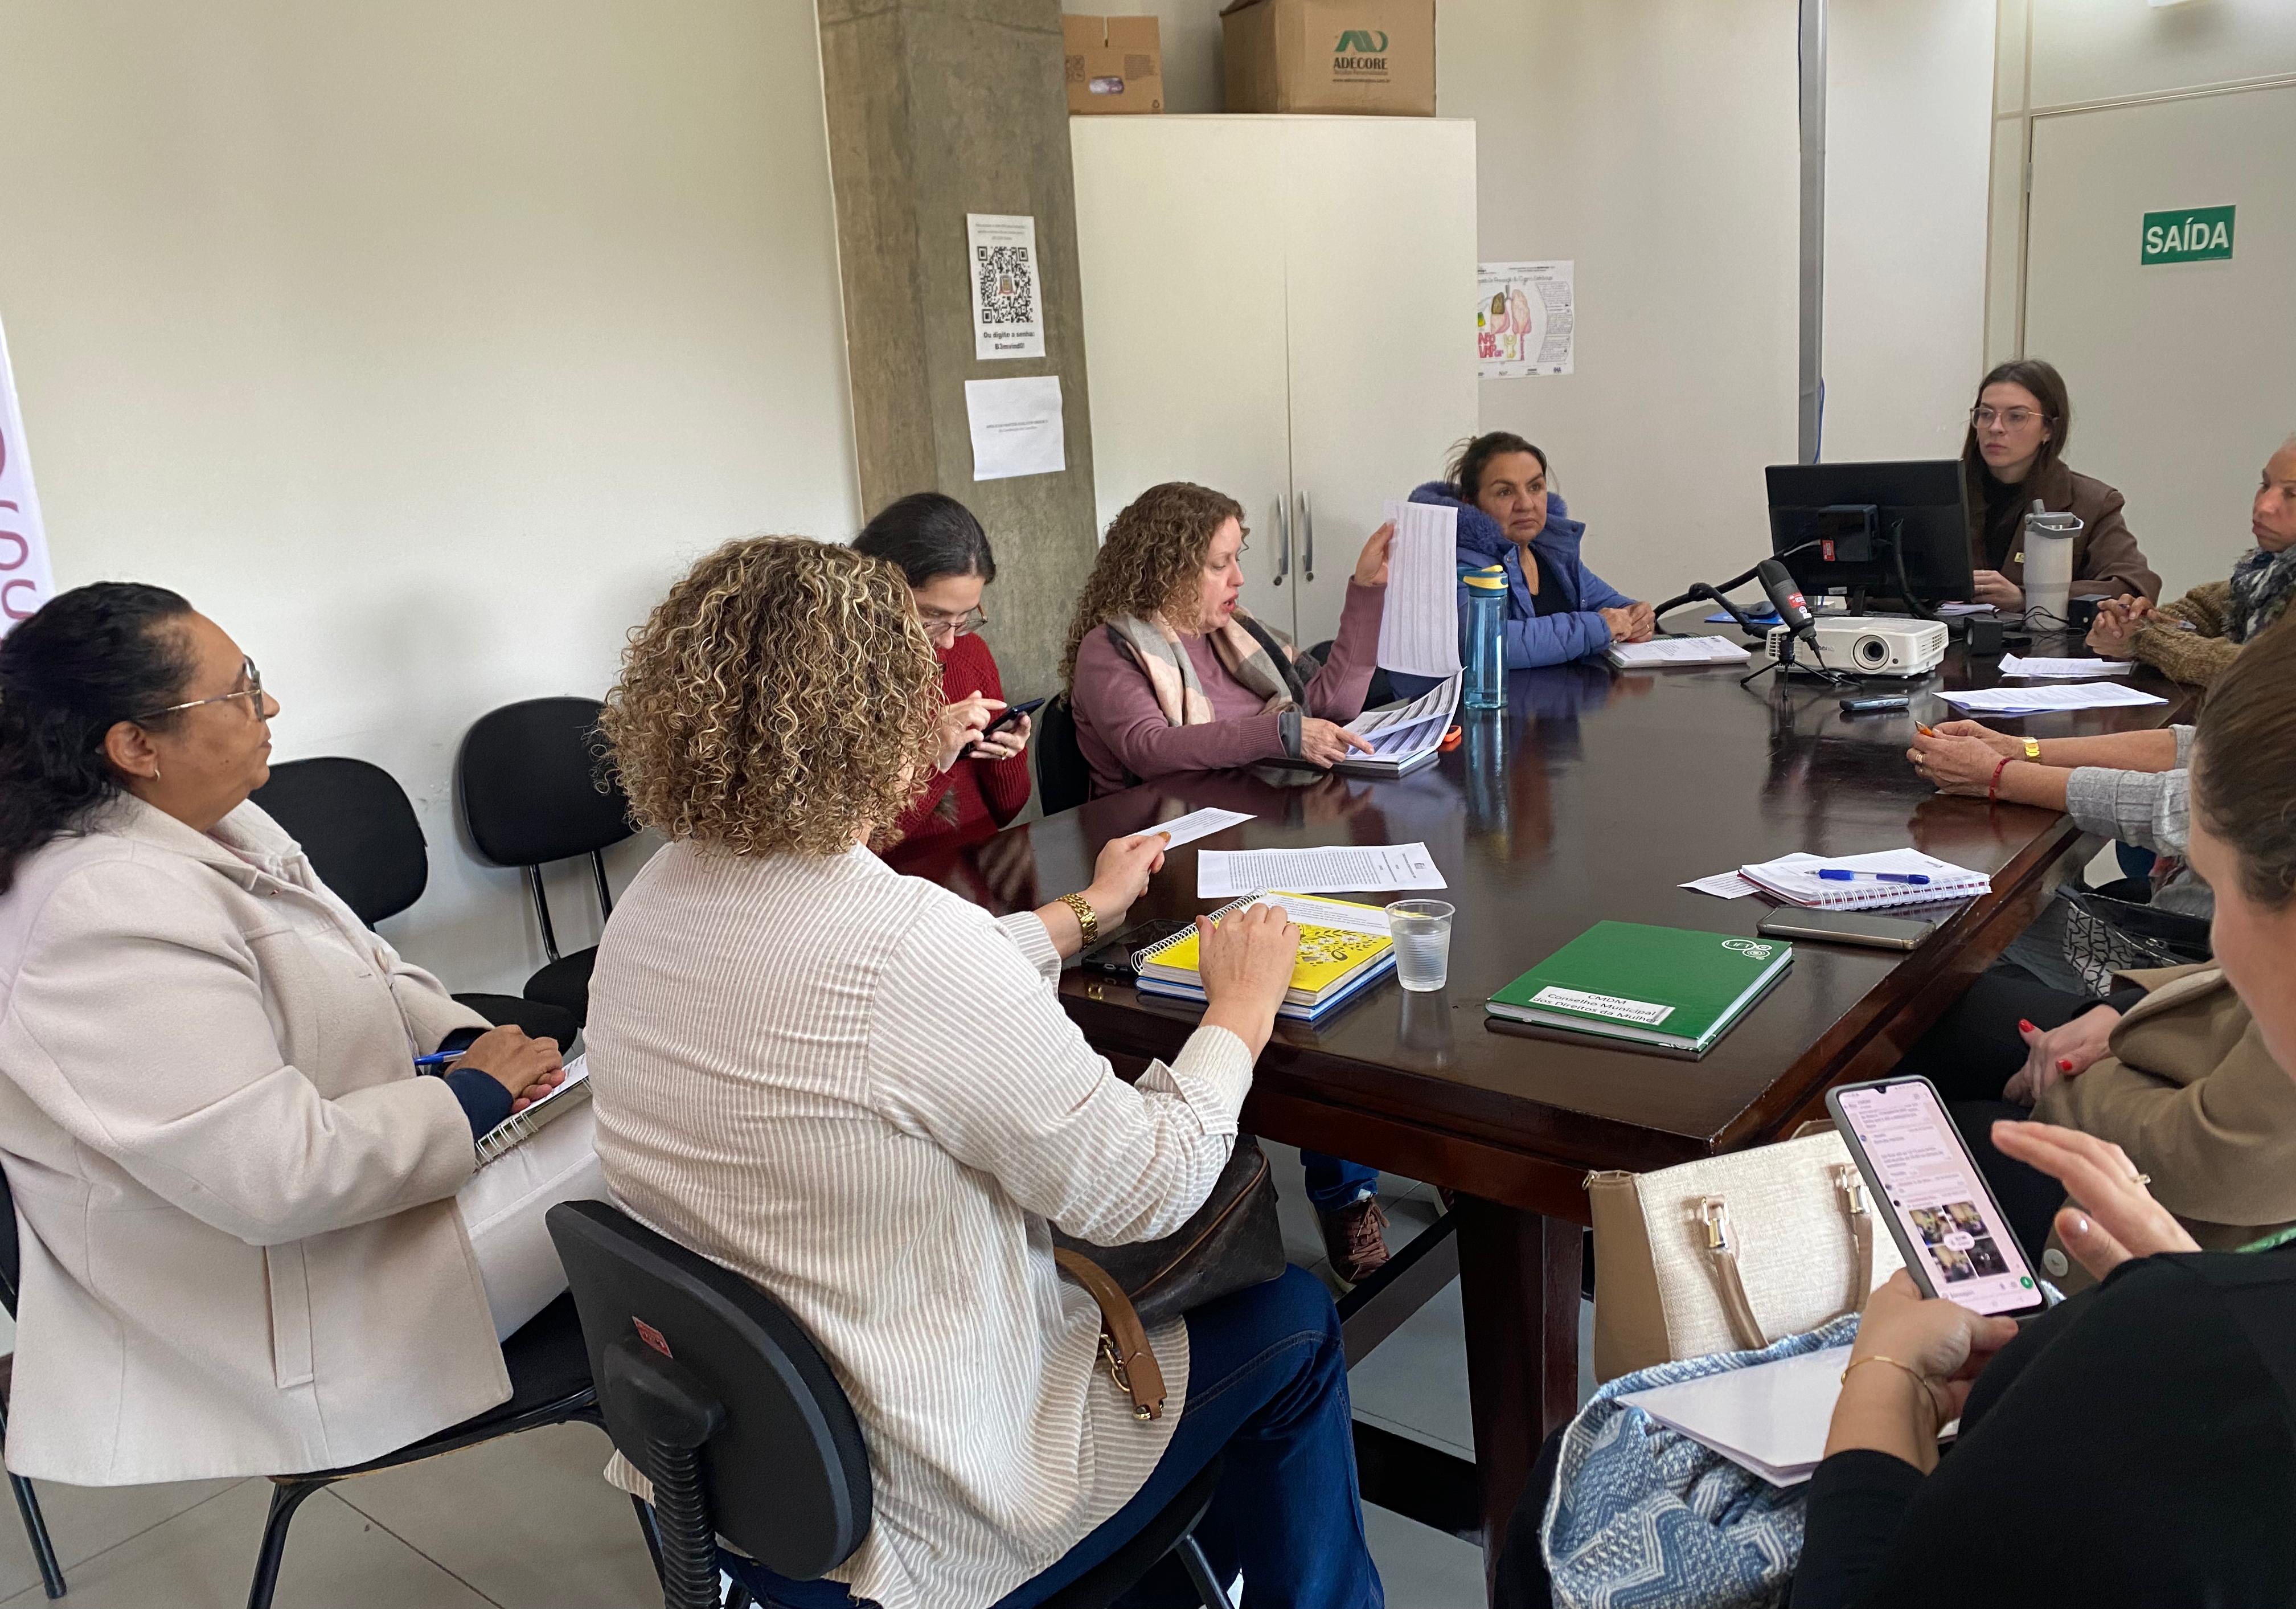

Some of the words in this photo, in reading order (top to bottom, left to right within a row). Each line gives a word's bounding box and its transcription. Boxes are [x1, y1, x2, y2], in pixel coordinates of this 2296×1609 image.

[1334, 58, 1388, 69] ADECORE
[2146, 217, 2229, 253] SAÍDA
[1548, 994, 1598, 1006] Conselho
[1598, 1003, 1657, 1016] Municipal
[1588, 995, 1627, 1005] CMDM
[1555, 1001, 1597, 1013] Direitos
[1616, 1013, 1659, 1023] Mulher
